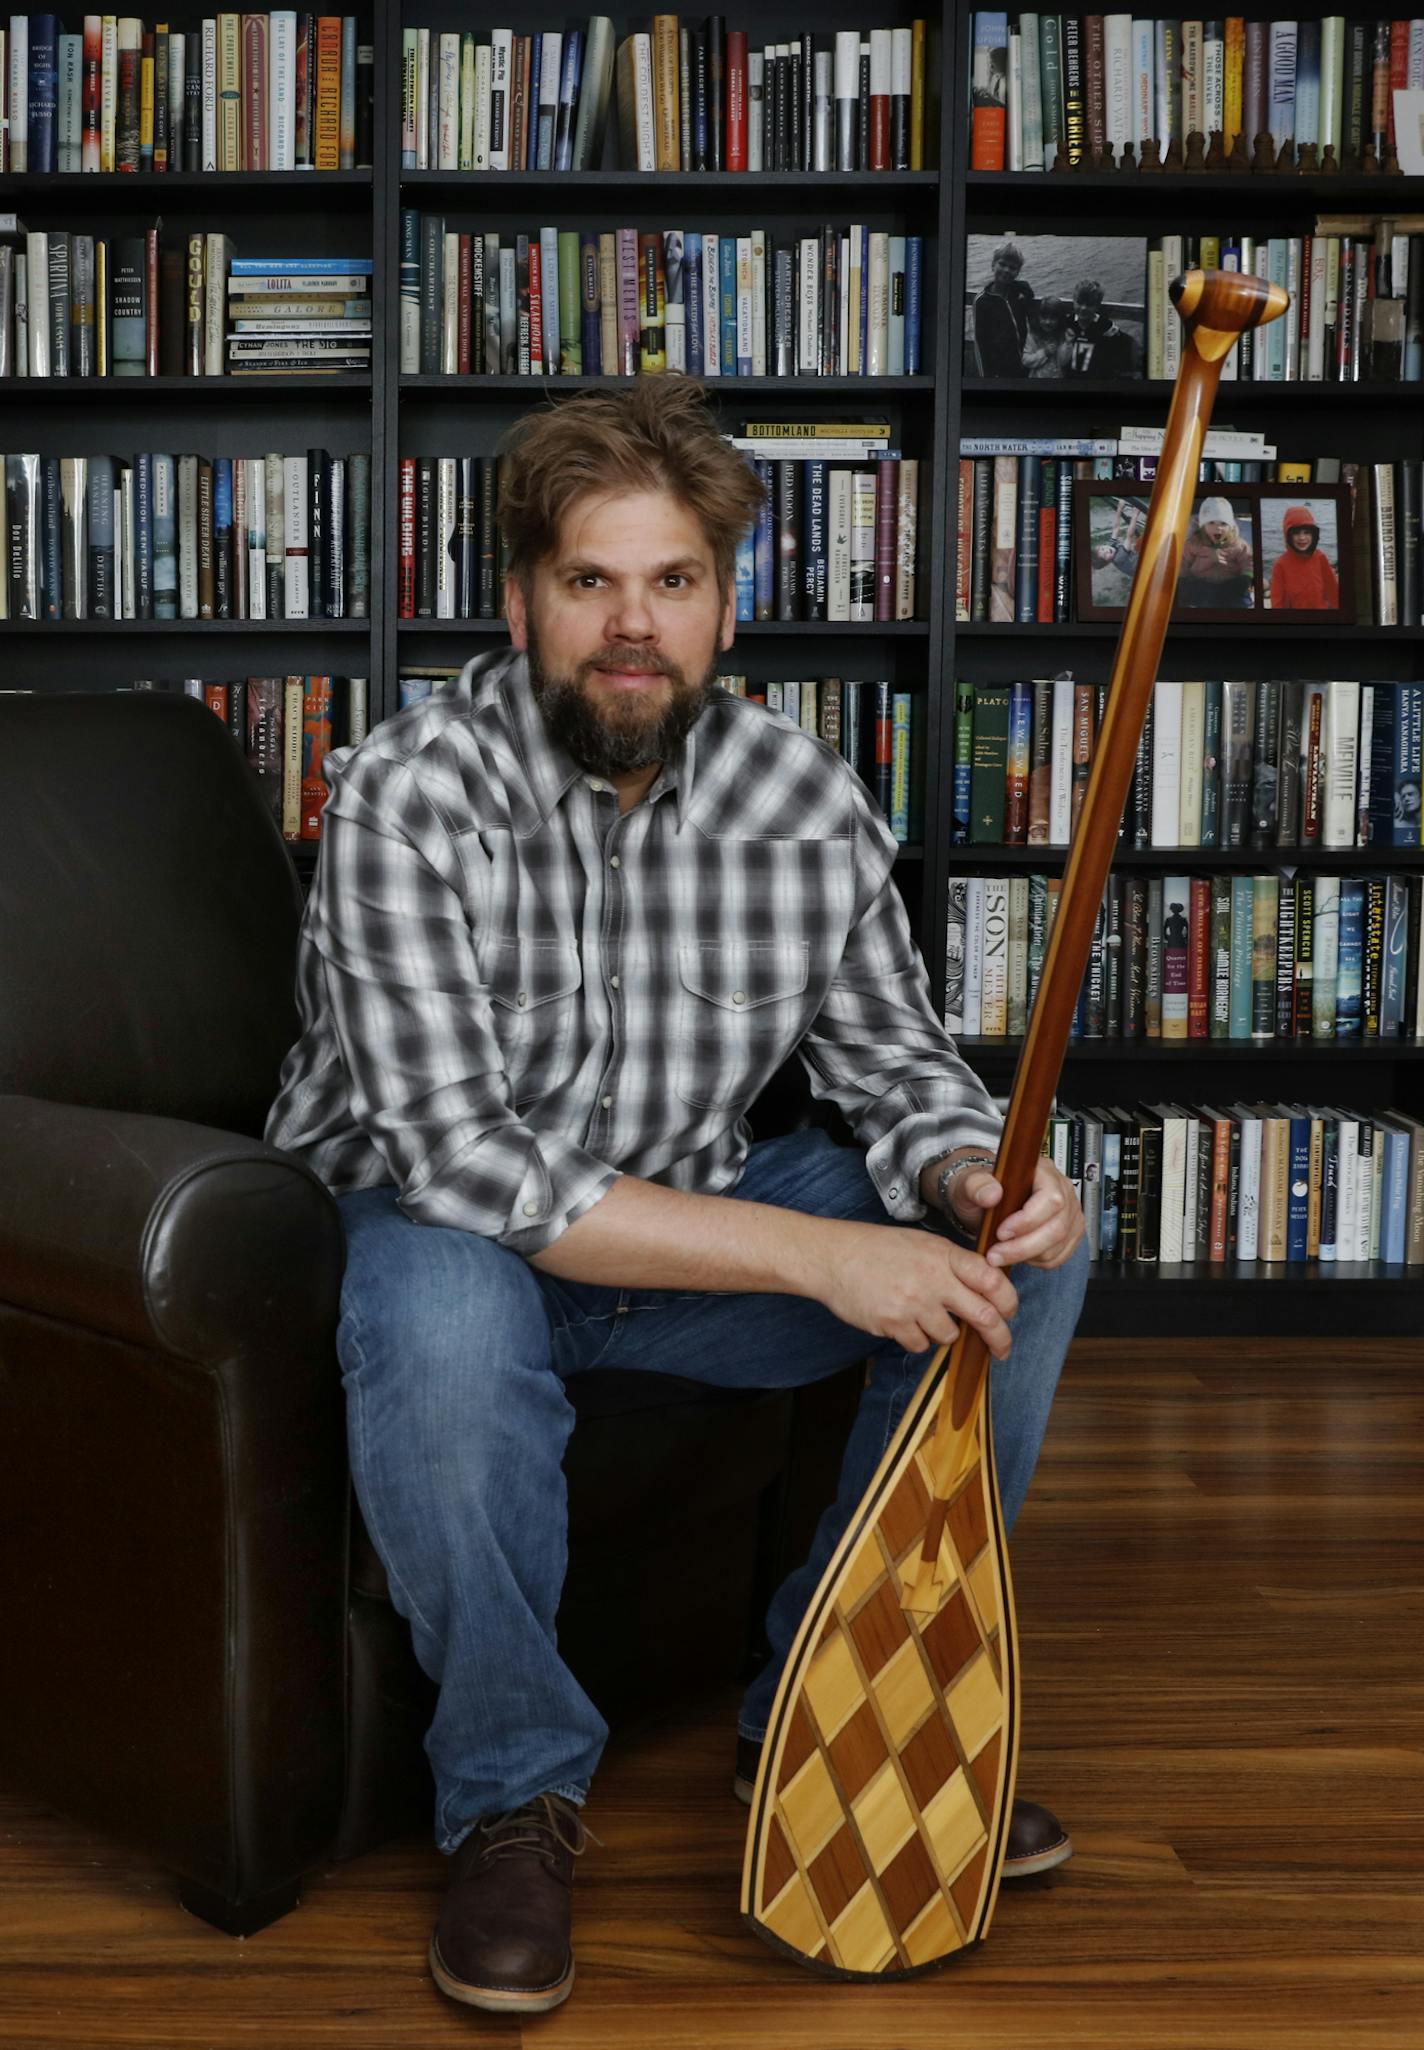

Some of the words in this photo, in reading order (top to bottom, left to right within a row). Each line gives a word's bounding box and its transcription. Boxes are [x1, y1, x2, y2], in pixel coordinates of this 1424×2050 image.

[1044, 19, 1057, 70] Cold
[1066, 20, 1079, 45] PETER
[1092, 24, 1100, 51] THE
[1276, 32, 1296, 40] A
[1412, 28, 1423, 54] IVAN
[205, 27, 213, 78] RICHARD
[278, 53, 284, 62] OF
[497, 47, 505, 67] Mystic
[1068, 49, 1079, 87] BEHRENS
[1275, 42, 1296, 75] GOOD
[1412, 58, 1422, 86] DOIG
[639, 68, 649, 115] COLDEST
[1273, 79, 1295, 104] MAN
[642, 122, 650, 155] NIGHT
[1094, 120, 1103, 153] SIDE
[50, 244, 68, 298] SPARTINA
[189, 240, 202, 322] GOULD
[474, 237, 483, 296] KNOCKEMSTIFF
[268, 279, 292, 289] LOLITA
[752, 425, 816, 436] BOTTOMLAND
[973, 443, 1000, 452] NORTH
[1001, 443, 1028, 452] WATER
[785, 465, 794, 486] RED
[812, 464, 822, 483] THE
[292, 474, 300, 541] OUTLANDER
[785, 490, 794, 520] MOON
[812, 488, 822, 515] DEAD
[12, 525, 21, 541] Don
[811, 519, 821, 552] LANDS
[978, 510, 987, 551] GIANTS
[13, 546, 22, 579] DeLillo
[97, 555, 105, 598] DEPTHS
[806, 567, 814, 595] PERCY
[817, 559, 825, 603] BENJAMIN
[977, 697, 1008, 706] PLATO
[1040, 690, 1050, 724] James
[1081, 692, 1089, 711] SAN
[1401, 689, 1409, 717] HANYA
[1413, 689, 1420, 697] A
[1412, 701, 1421, 743] LITTLE
[1015, 712, 1026, 798] JEWELWEED
[1038, 727, 1050, 762] Salter
[1400, 720, 1409, 773] YANAGIHARA
[1412, 747, 1420, 773] LIFE
[1311, 745, 1319, 819] LEVIATHAN
[1331, 737, 1355, 800] MELVILLE
[1135, 779, 1143, 812] CANIN
[1216, 897, 1229, 913] SOIL
[1245, 891, 1253, 908] JOY
[1303, 890, 1311, 915] SCOTT
[985, 895, 1006, 958] SON
[1016, 917, 1024, 949] RIVER
[1235, 909, 1243, 944] Visiting
[1245, 914, 1253, 965] WILLIAMS
[1302, 920, 1311, 957] SPENCER
[1091, 940, 1101, 957] THE
[1197, 942, 1204, 952] OF
[1277, 899, 1295, 992] LIGHTKEEPERS
[1015, 954, 1023, 999] THIEVES
[1149, 936, 1161, 998] Browsings
[1196, 956, 1204, 990] ORDER
[1216, 949, 1229, 977] JAMIE
[1234, 949, 1242, 988] Privilege
[984, 968, 993, 1019] MEYER
[1090, 962, 1101, 1001] THICKET
[1215, 979, 1229, 1022] KORNEGAY
[1231, 1166, 1239, 1191] Indiana,
[1327, 1156, 1337, 1189] Touch
[1346, 1151, 1354, 1185] American
[1230, 1192, 1238, 1216] Indiana
[1345, 1188, 1353, 1214] Classics
[1412, 1169, 1424, 1213] Vanishing
[1413, 1216, 1422, 1242] Moon
